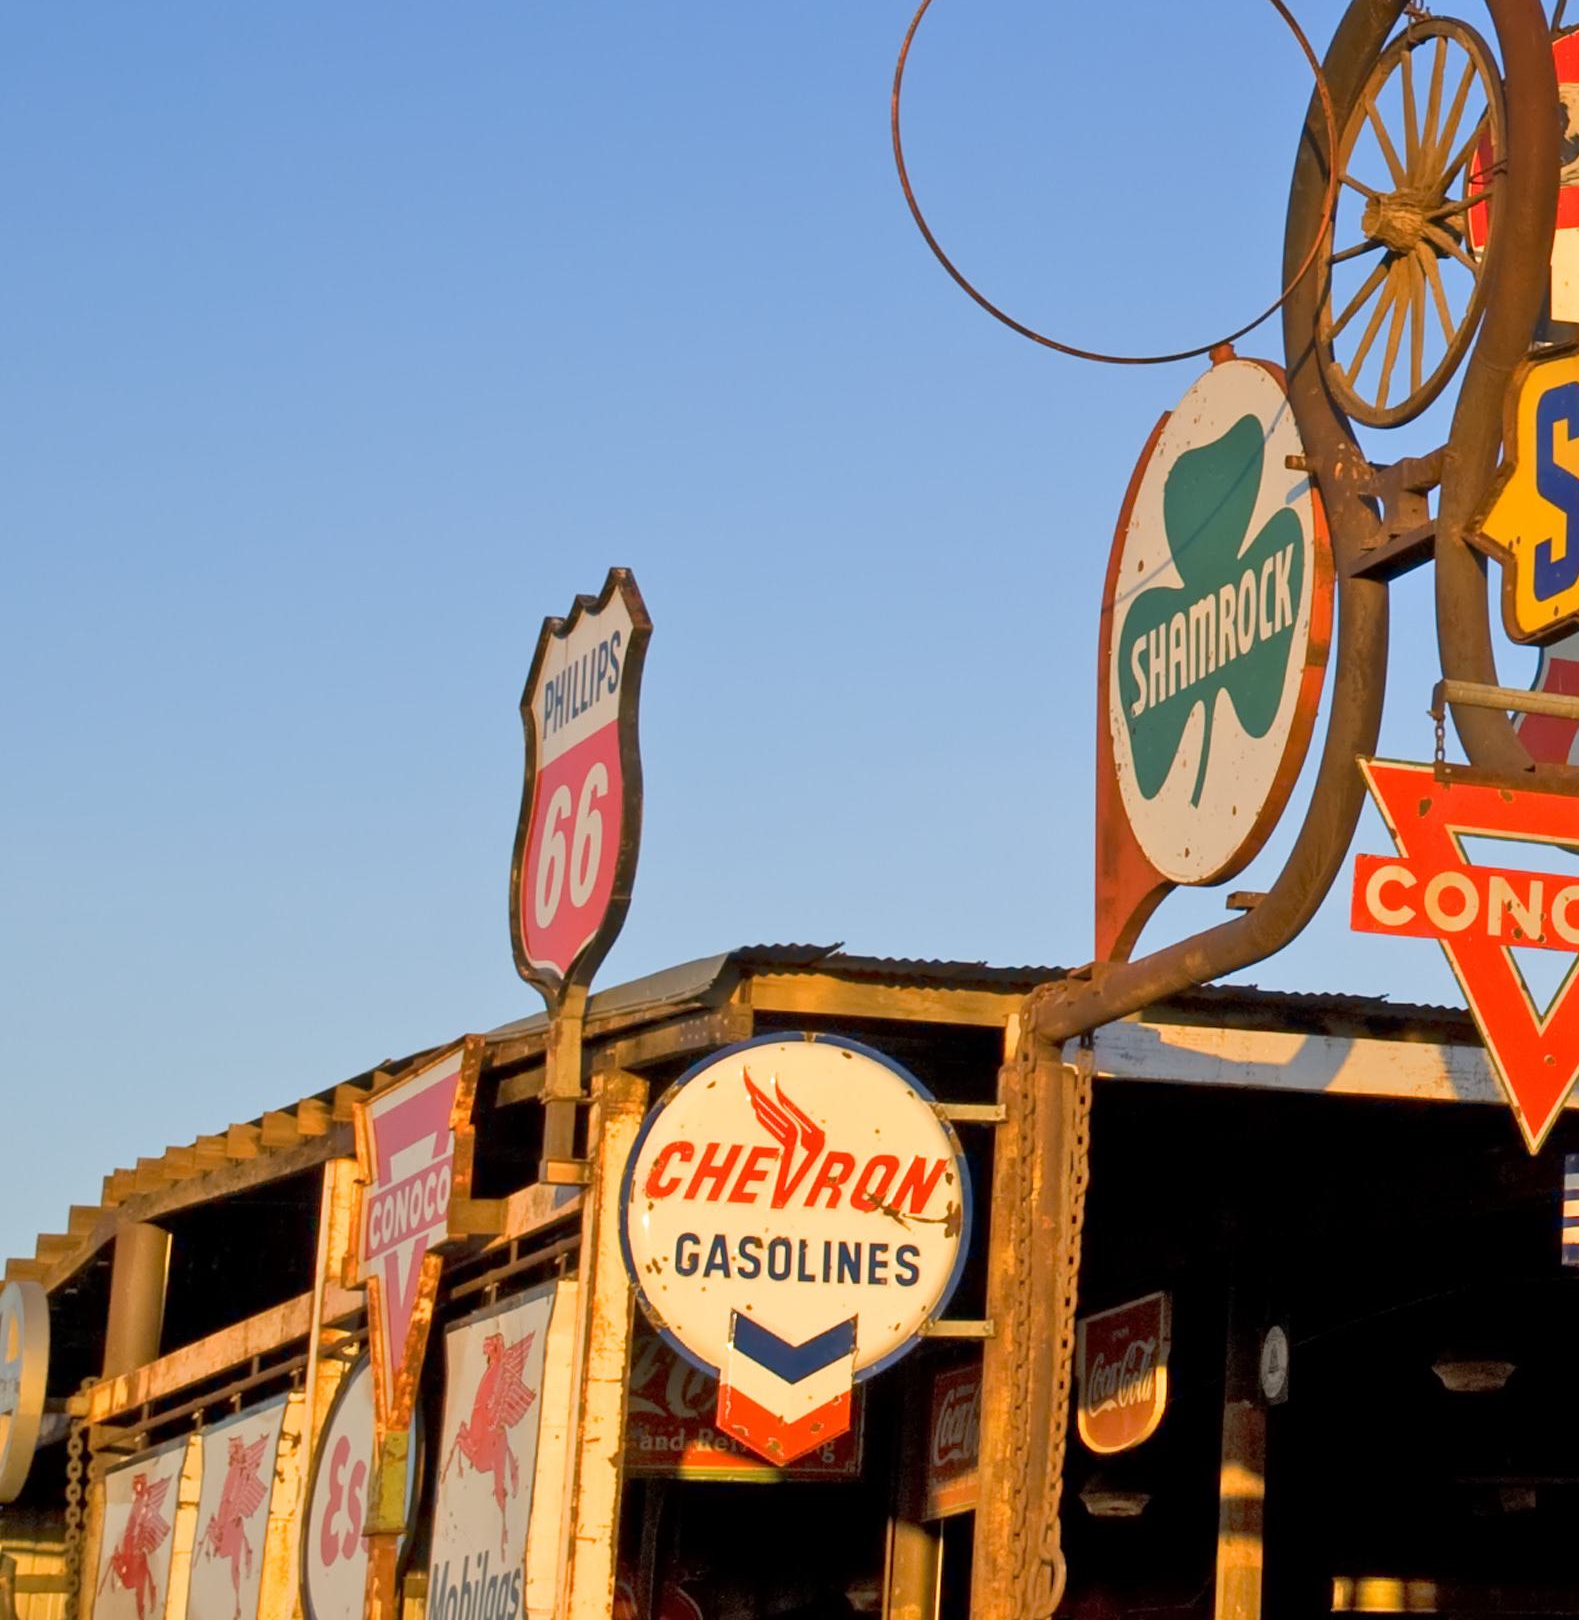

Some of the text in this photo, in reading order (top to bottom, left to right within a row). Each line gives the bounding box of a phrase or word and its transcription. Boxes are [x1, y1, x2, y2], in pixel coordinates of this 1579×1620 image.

[1131, 542, 1295, 718] SHAMROCK
[543, 629, 621, 740] PHILLIPS
[535, 762, 608, 929] 66
[369, 1164, 451, 1250] CONOCO
[645, 1132, 948, 1214] CHEVRON
[675, 1233, 921, 1287] GASOLINES
